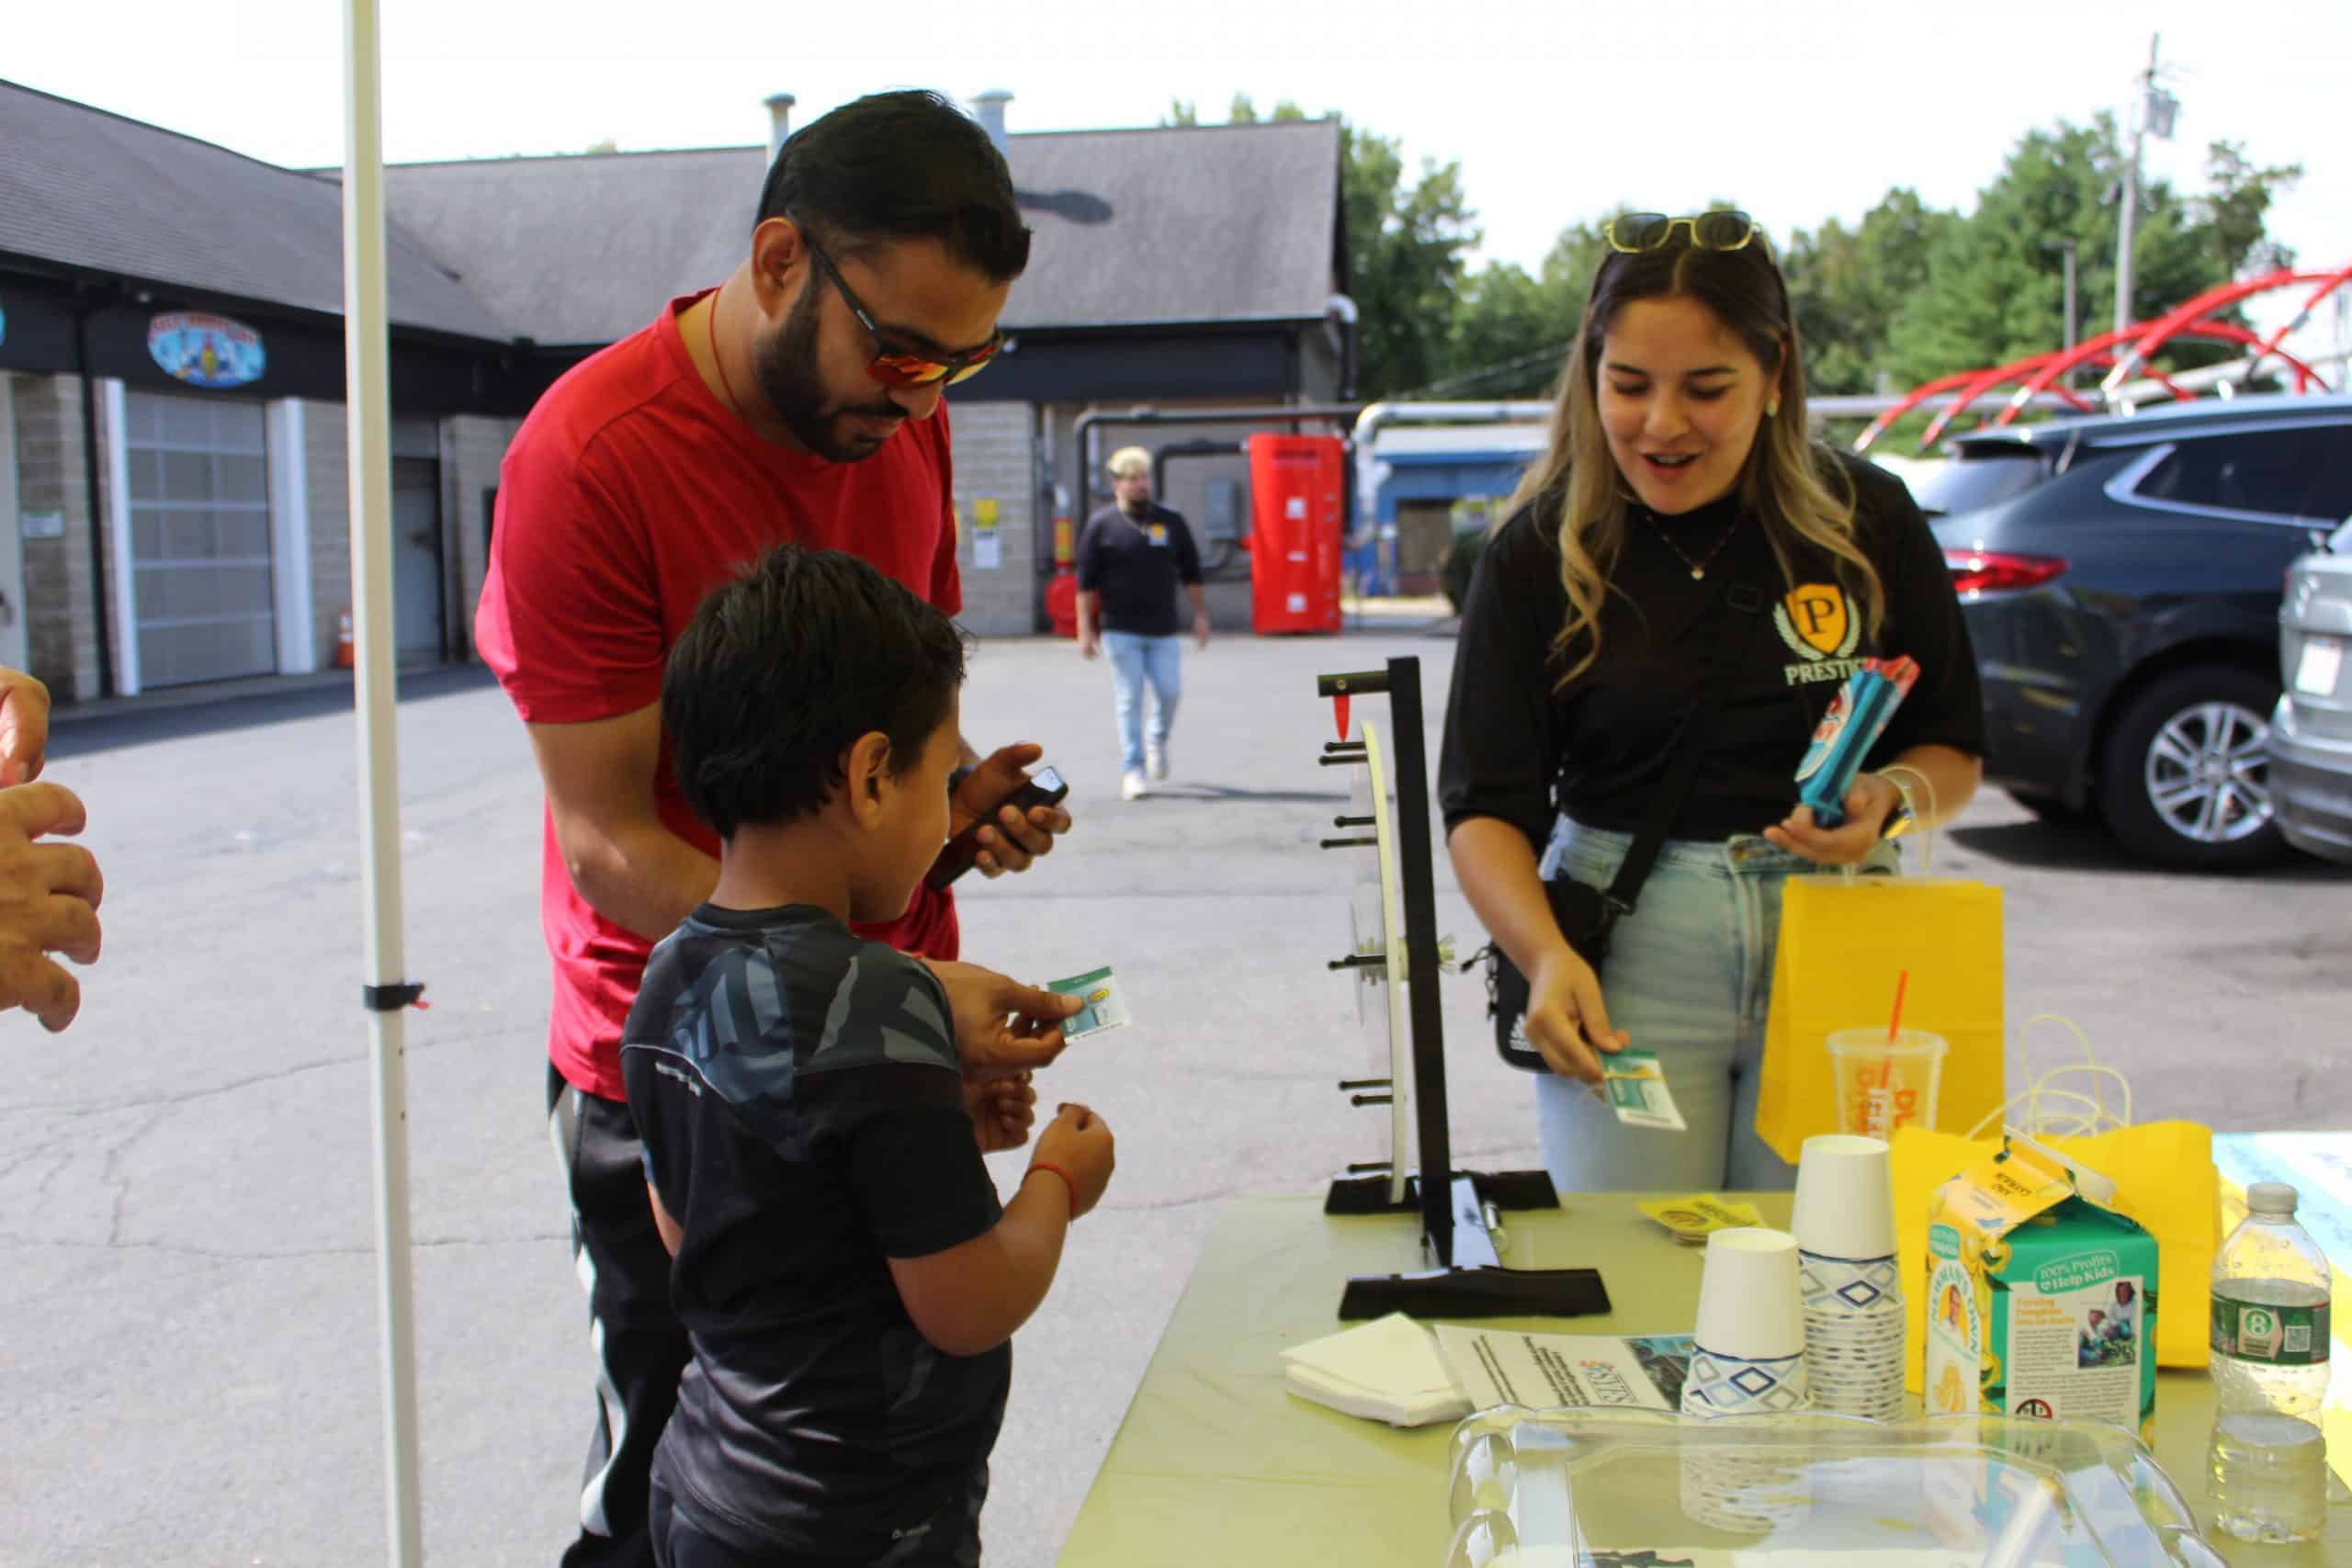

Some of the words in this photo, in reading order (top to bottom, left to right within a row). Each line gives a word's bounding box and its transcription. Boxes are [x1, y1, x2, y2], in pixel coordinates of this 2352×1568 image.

[1800, 599, 1836, 635] P
[1783, 658, 1867, 686] PRESTI
[2073, 1255, 2112, 1273] Profits
[2052, 1273, 2083, 1291] Help
[2086, 1266, 2116, 1282] Kids
